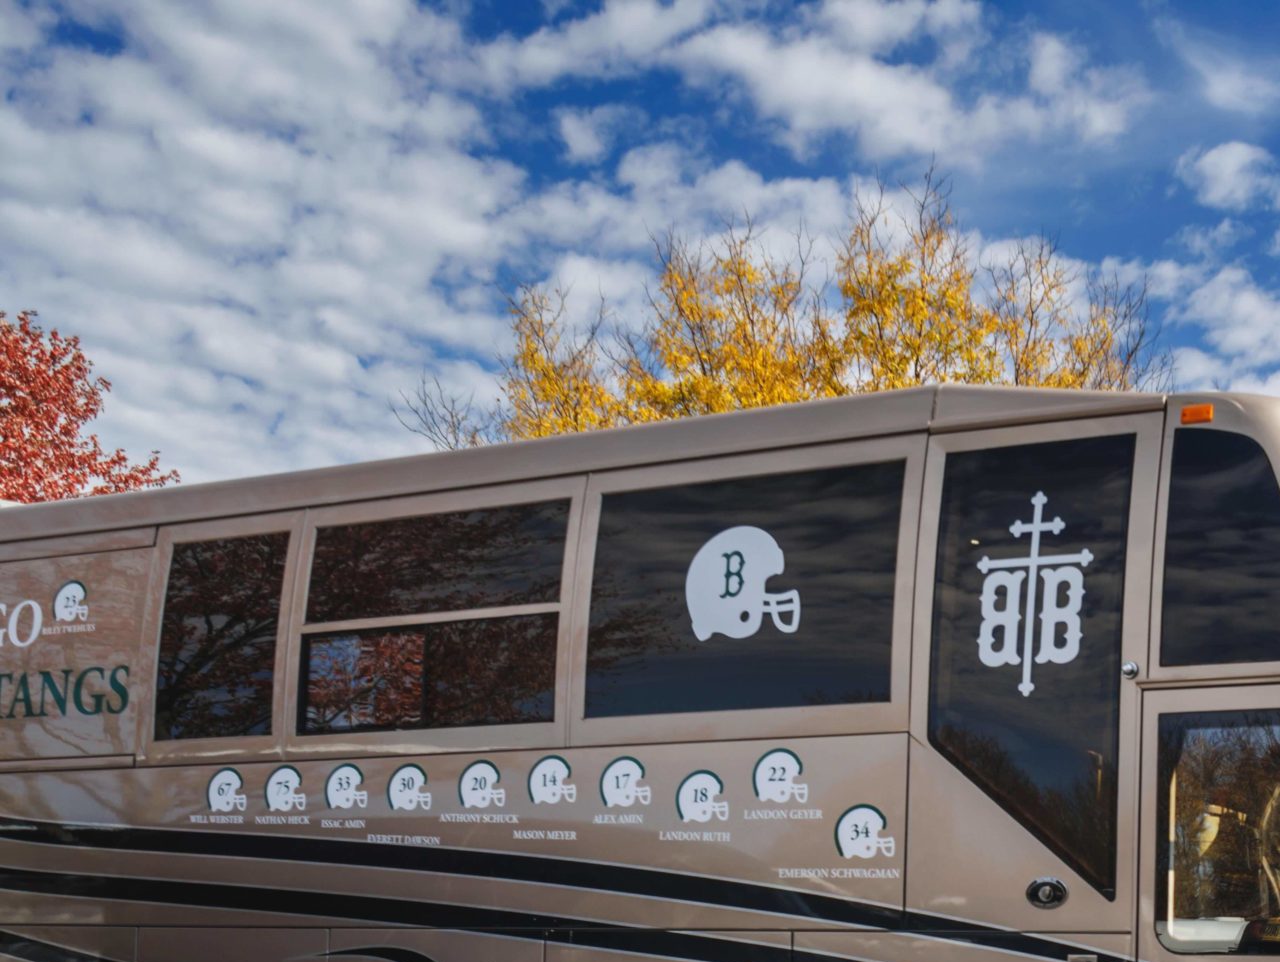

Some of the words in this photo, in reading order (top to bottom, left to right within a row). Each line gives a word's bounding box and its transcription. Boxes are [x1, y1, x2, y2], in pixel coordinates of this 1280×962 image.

[719, 551, 746, 599] B
[0, 599, 43, 648] O
[542, 770, 557, 788] 14
[614, 773, 631, 789] 17
[768, 766, 787, 782] 22
[217, 782, 232, 797] 67
[276, 780, 290, 797] 75
[335, 776, 351, 792] 33
[398, 776, 415, 793] 30
[471, 776, 487, 791] 20
[693, 787, 709, 803] 18
[190, 815, 208, 824] WILL
[209, 815, 244, 824] WEBSTER
[255, 816, 287, 825] NATHAN
[288, 815, 310, 825] HECK
[440, 813, 481, 823] ANTHONY
[482, 814, 520, 824] SCHUCK
[593, 814, 618, 824] ALEX
[743, 809, 788, 820] LANDON
[789, 808, 823, 819] GEYER
[513, 830, 545, 840] MASON
[546, 830, 577, 841] MEYER
[659, 830, 700, 841] LANDON
[702, 831, 731, 842] RUTH
[850, 821, 871, 841] 34
[367, 834, 405, 844] EVERETT
[405, 835, 440, 846] DAWSON
[778, 867, 829, 879] EMERSON
[830, 868, 900, 879] SCHWAGMAN
